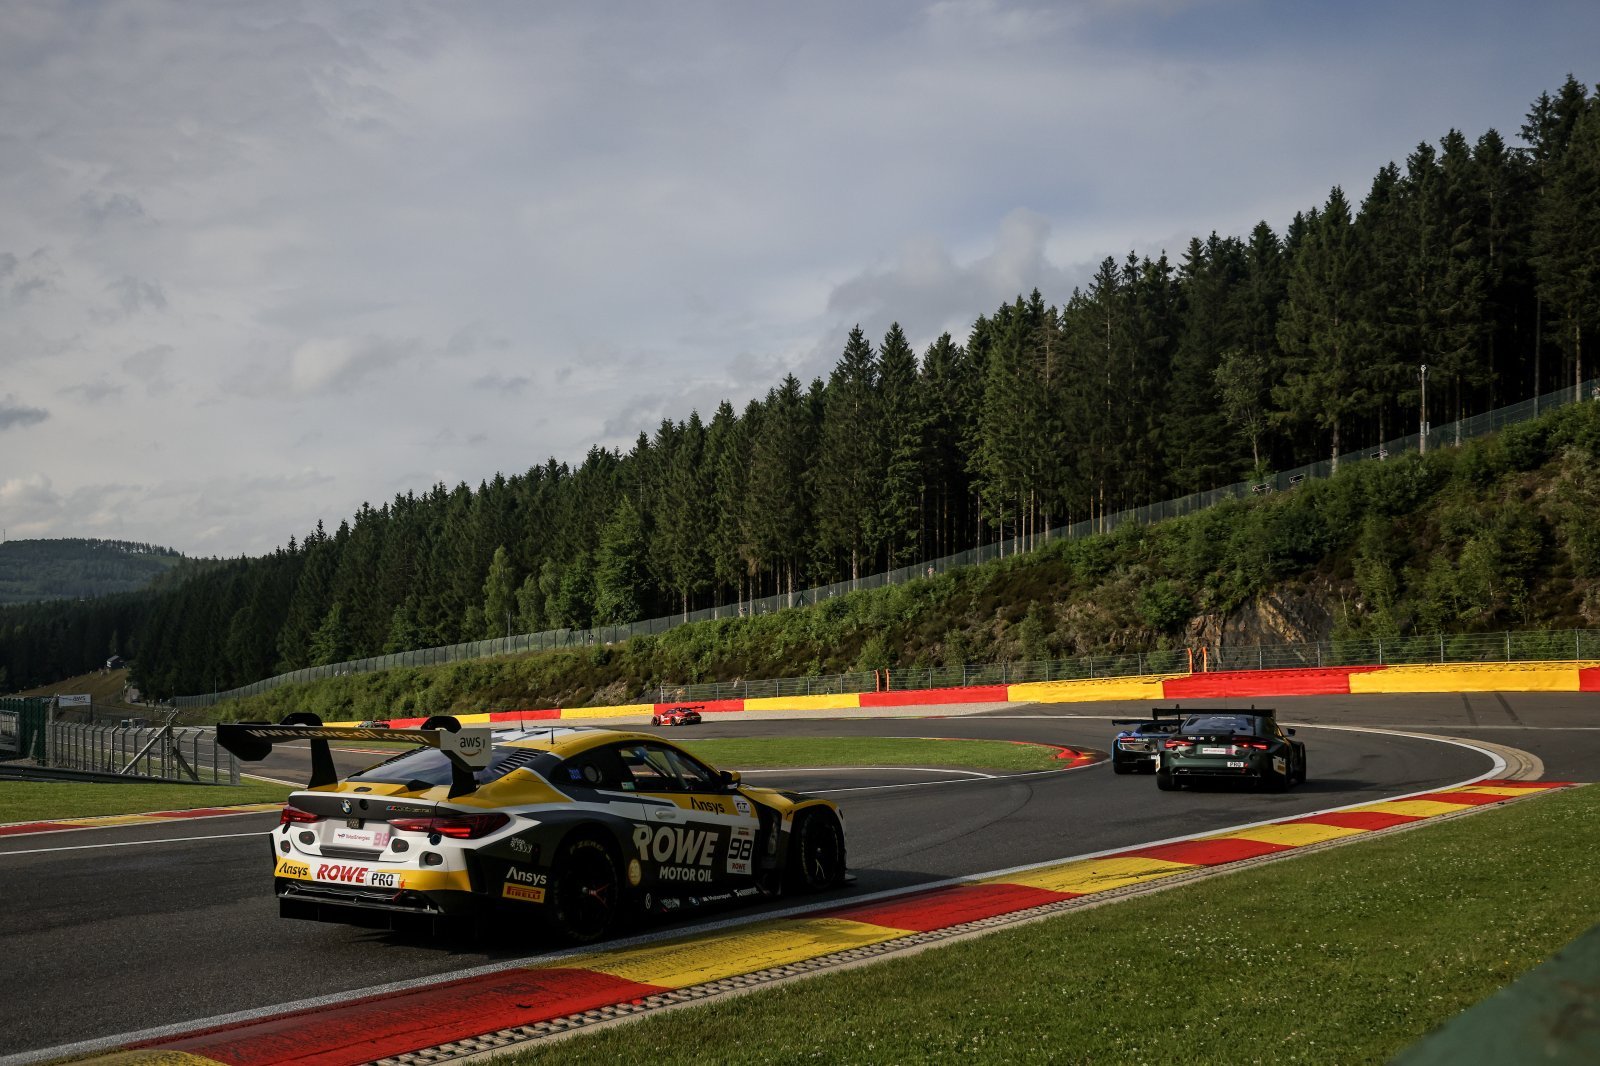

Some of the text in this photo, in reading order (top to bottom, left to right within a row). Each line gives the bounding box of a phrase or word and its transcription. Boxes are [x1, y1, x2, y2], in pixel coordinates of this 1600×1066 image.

[246, 728, 430, 745] www.rowe-oil.com
[459, 736, 481, 748] aws
[690, 797, 725, 815] Ansys
[373, 832, 391, 848] 98
[633, 823, 719, 866] ROWE
[728, 838, 753, 861] 98
[279, 863, 309, 877] Ansys
[316, 864, 368, 884] ROWE
[659, 866, 713, 883] MOTOR OIL
[731, 863, 746, 871] ROWE
[371, 872, 394, 887] PRO
[506, 866, 547, 886] Ansys
[506, 886, 541, 900] PIRELLI
